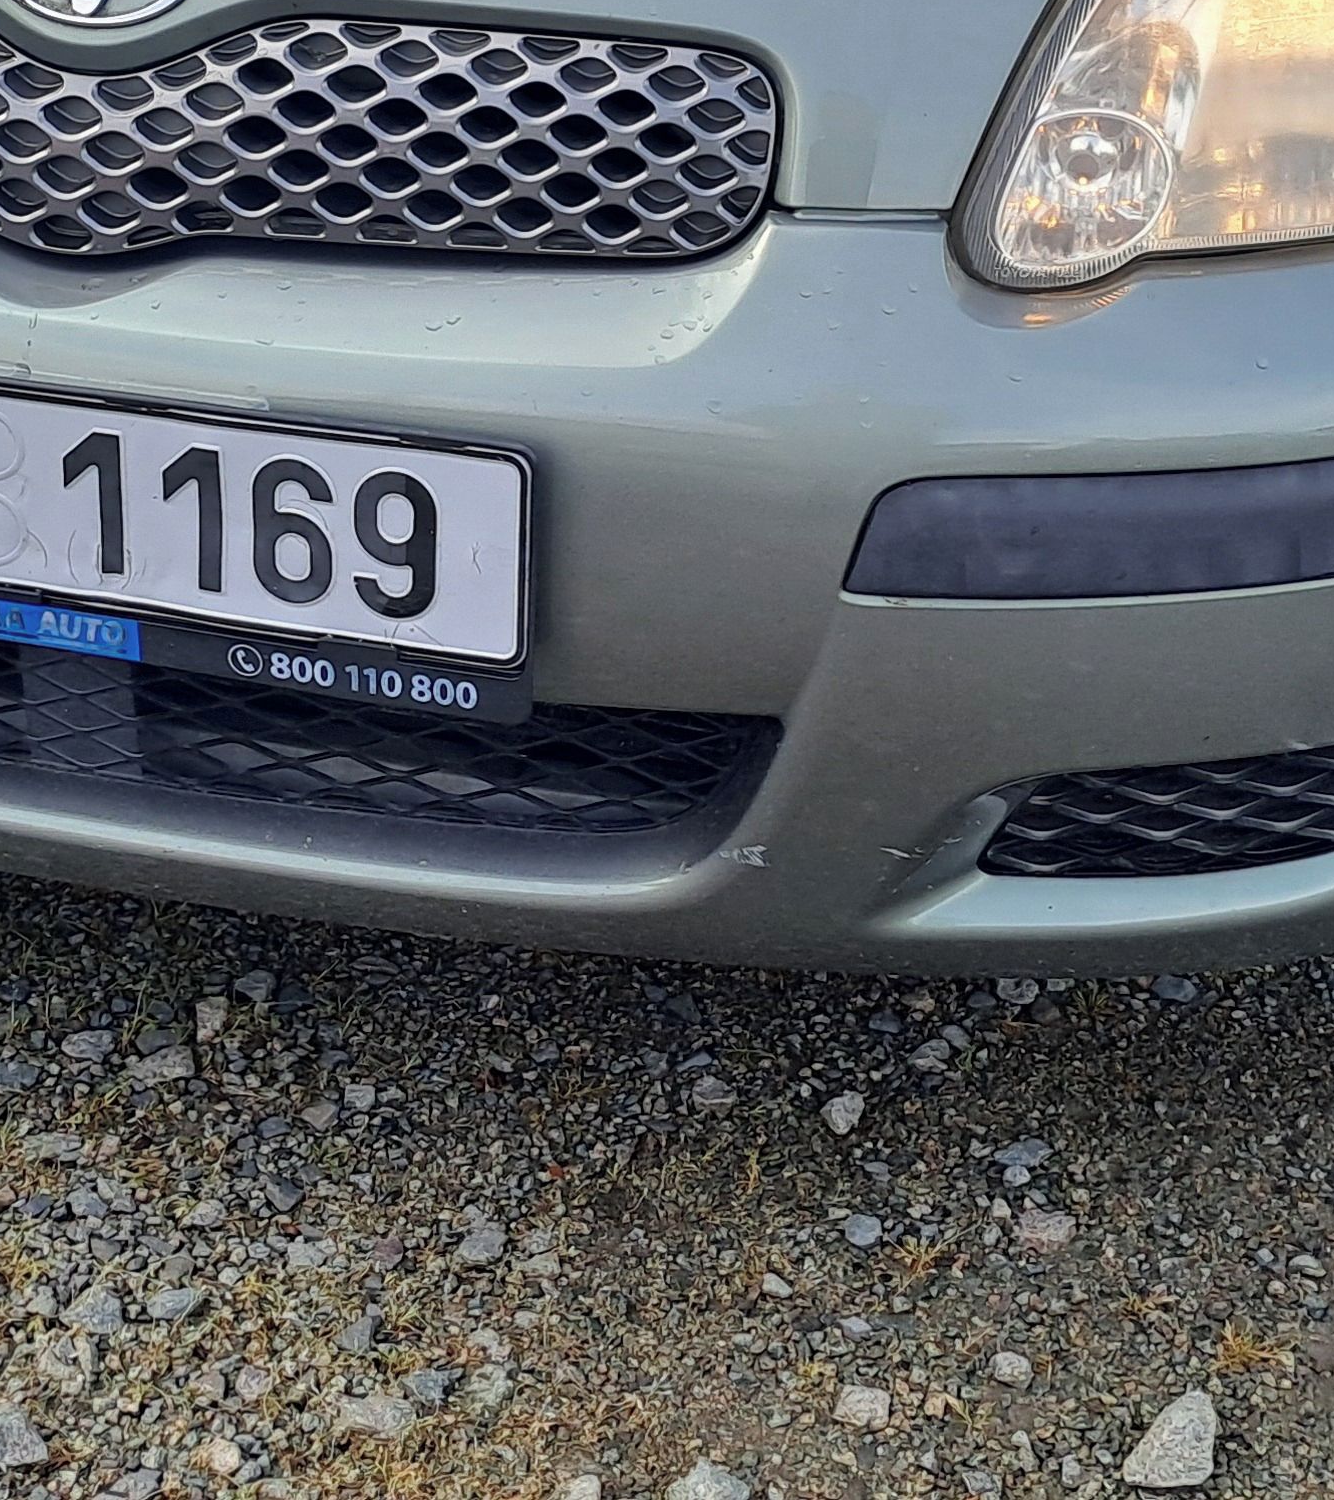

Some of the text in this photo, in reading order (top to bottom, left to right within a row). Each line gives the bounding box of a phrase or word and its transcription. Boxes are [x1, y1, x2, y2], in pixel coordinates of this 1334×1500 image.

[62, 429, 438, 620] 1169
[37, 610, 127, 646] AUTO
[269, 652, 479, 710] 800 110 800
